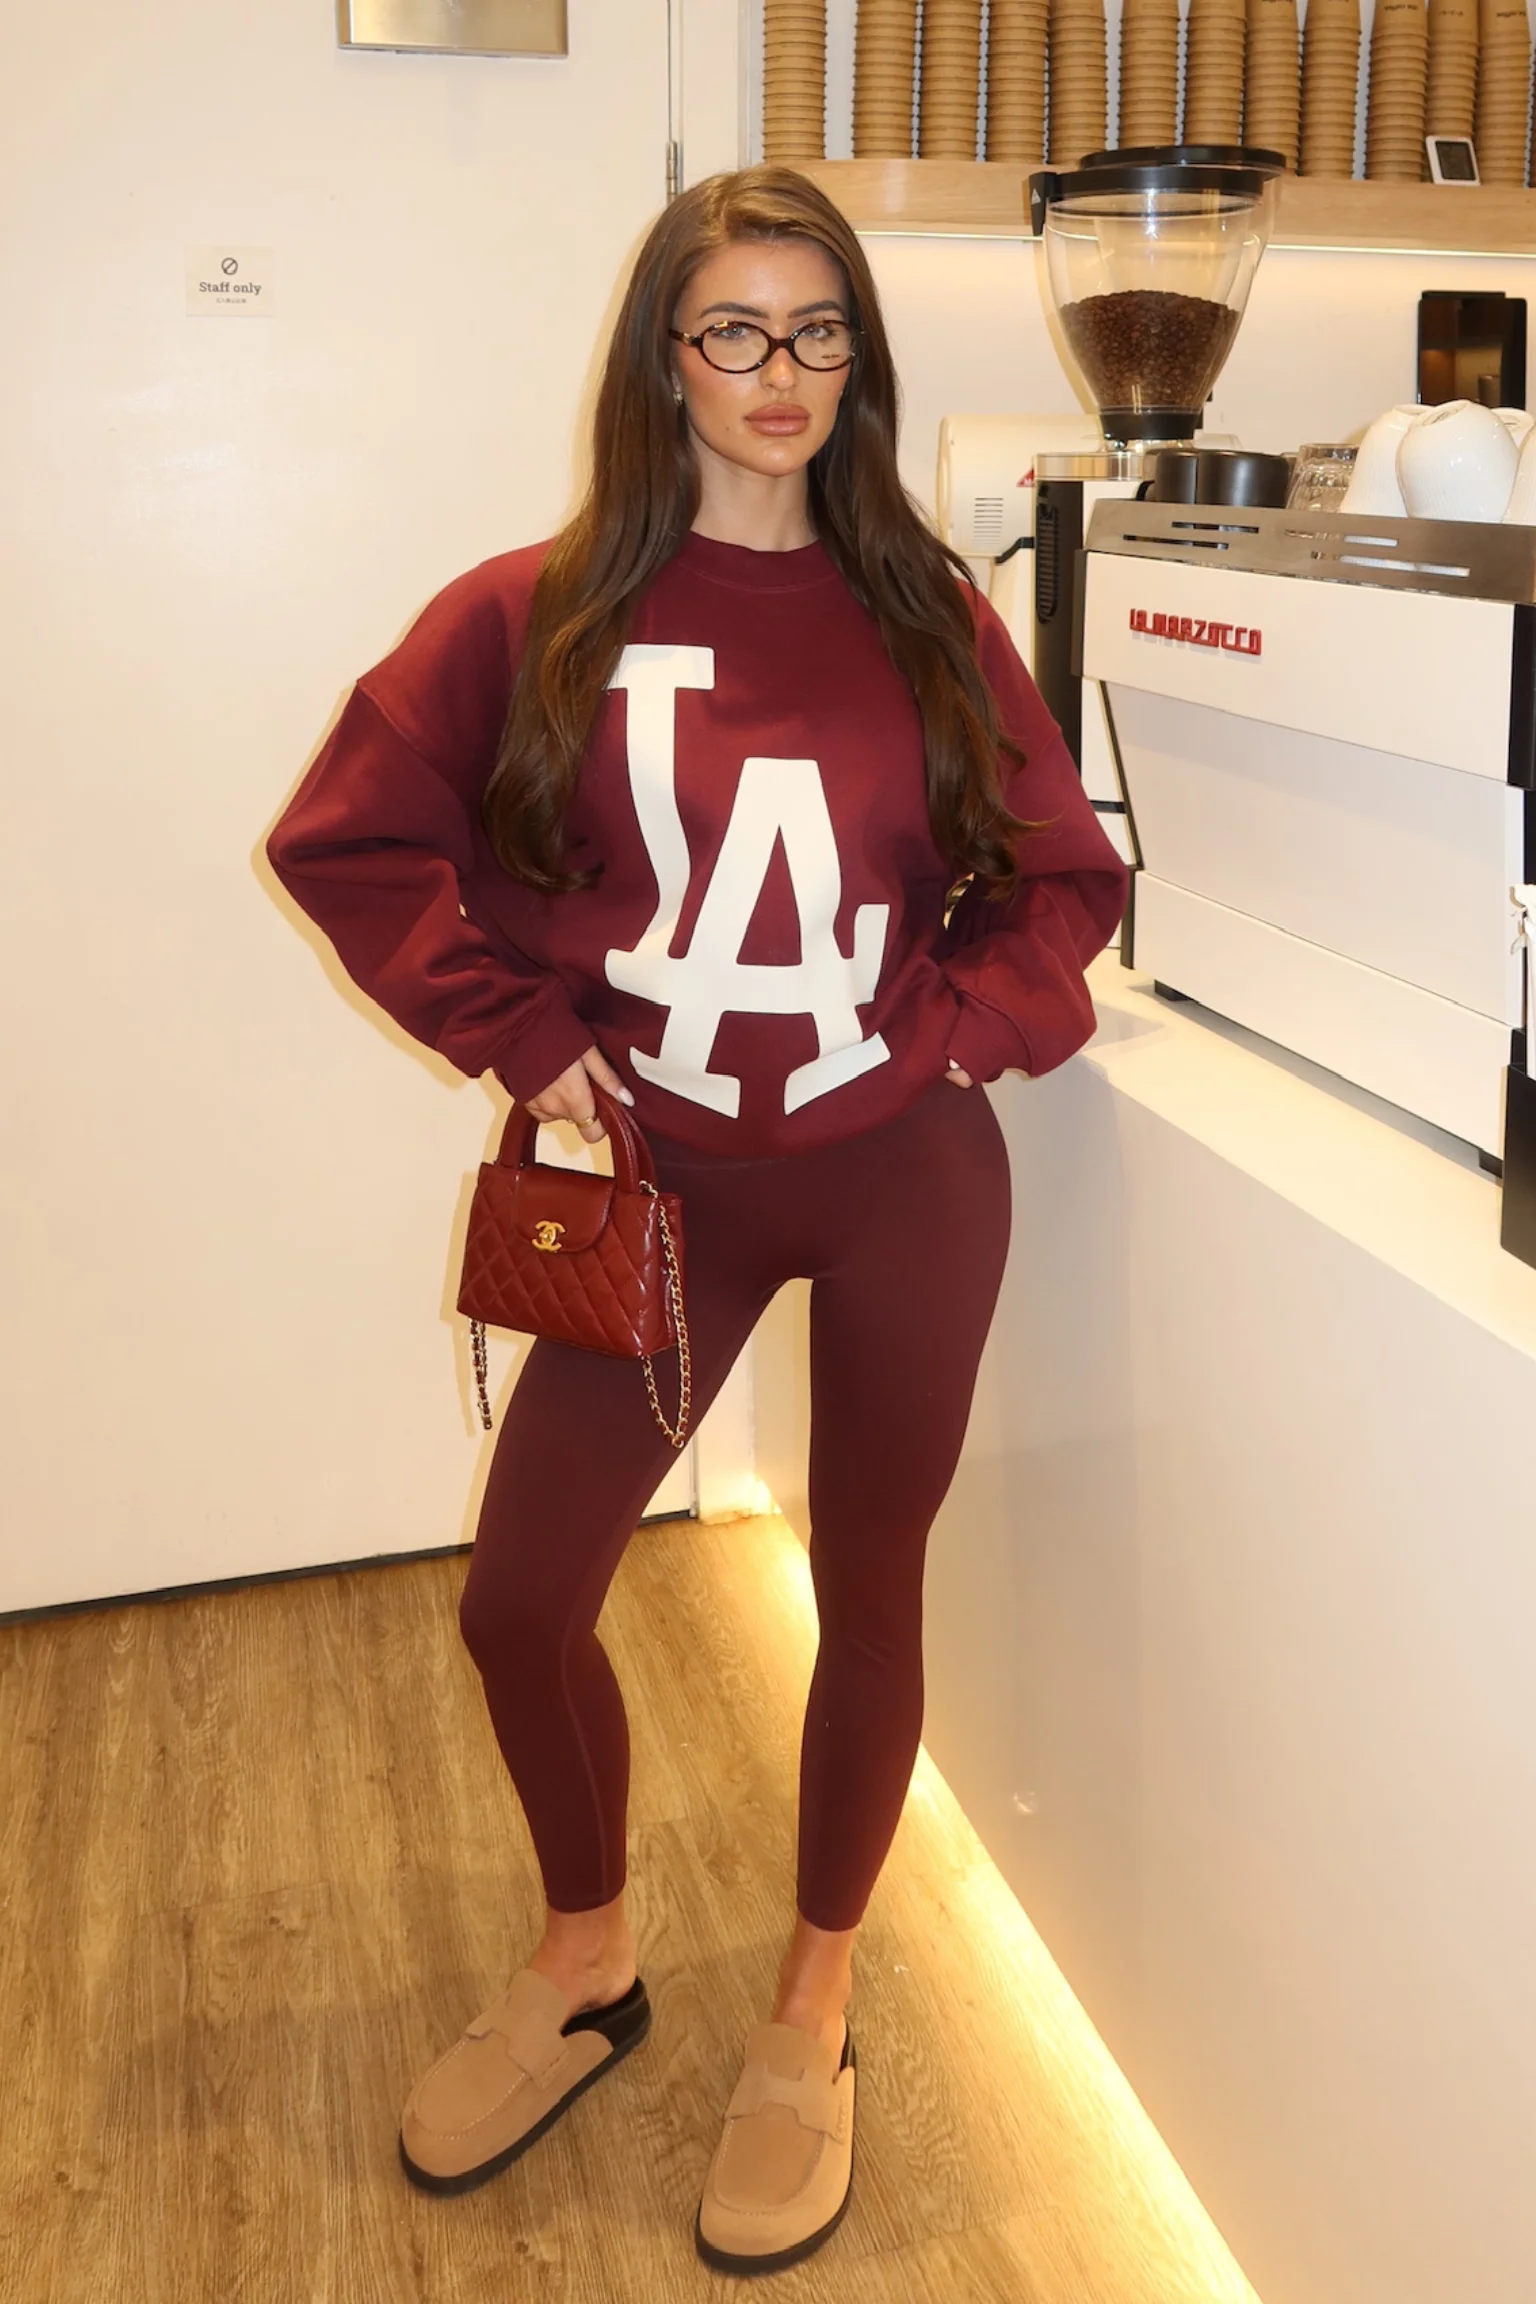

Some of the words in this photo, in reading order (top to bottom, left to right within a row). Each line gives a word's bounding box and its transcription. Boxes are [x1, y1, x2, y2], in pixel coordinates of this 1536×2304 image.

[199, 281, 230, 293] Staff
[233, 281, 262, 296] only
[1152, 612, 1262, 656] MARZOCCO
[604, 643, 891, 1119] LA
